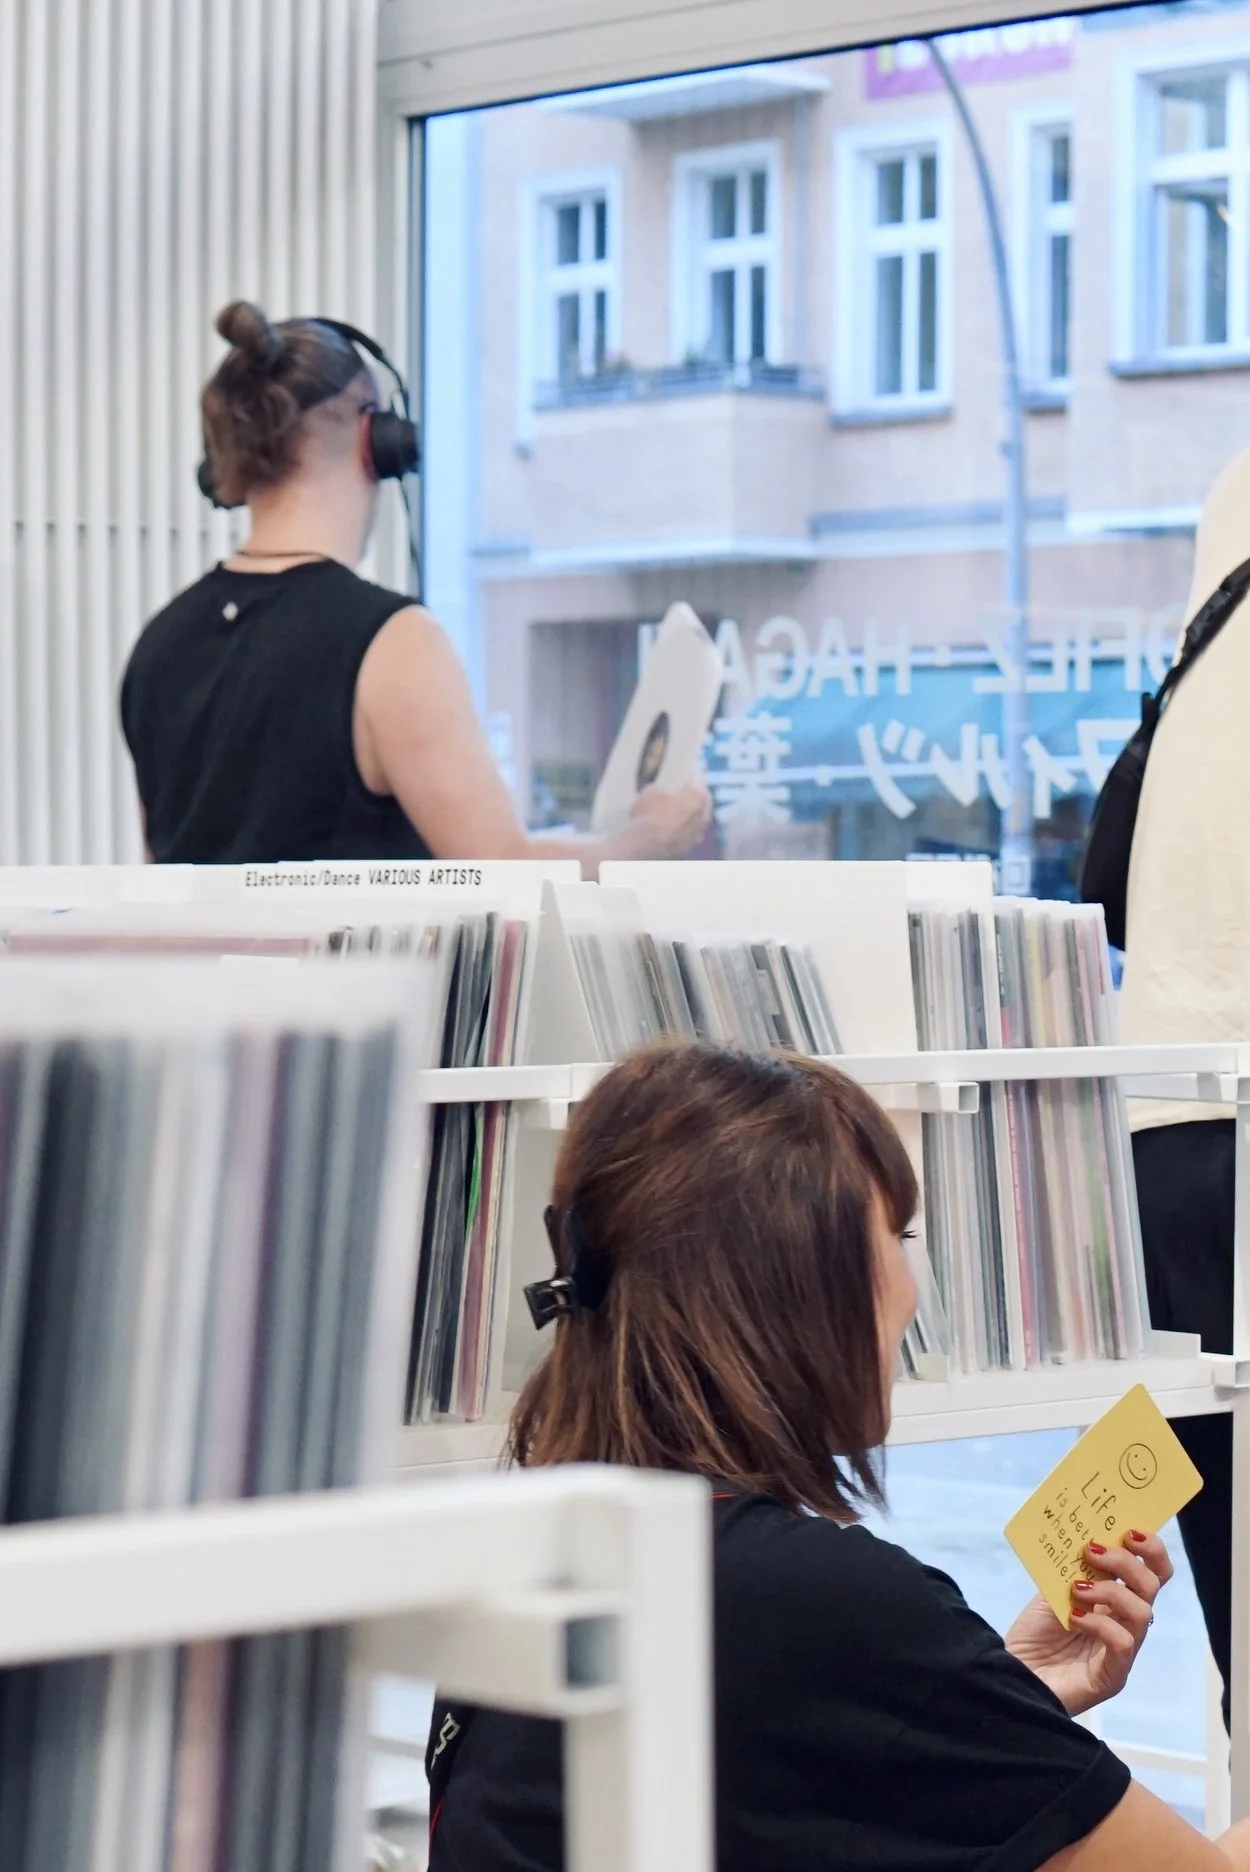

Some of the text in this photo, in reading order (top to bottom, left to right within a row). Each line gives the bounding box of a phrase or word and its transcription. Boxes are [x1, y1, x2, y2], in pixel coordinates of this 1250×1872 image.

[245, 868, 482, 887] Electronic/Dance VARIOUS ARTISTS
[1056, 1487, 1067, 1508] is
[1081, 1471, 1117, 1531] Life
[1043, 1505, 1073, 1550] when
[1038, 1533, 1077, 1583] smile!
